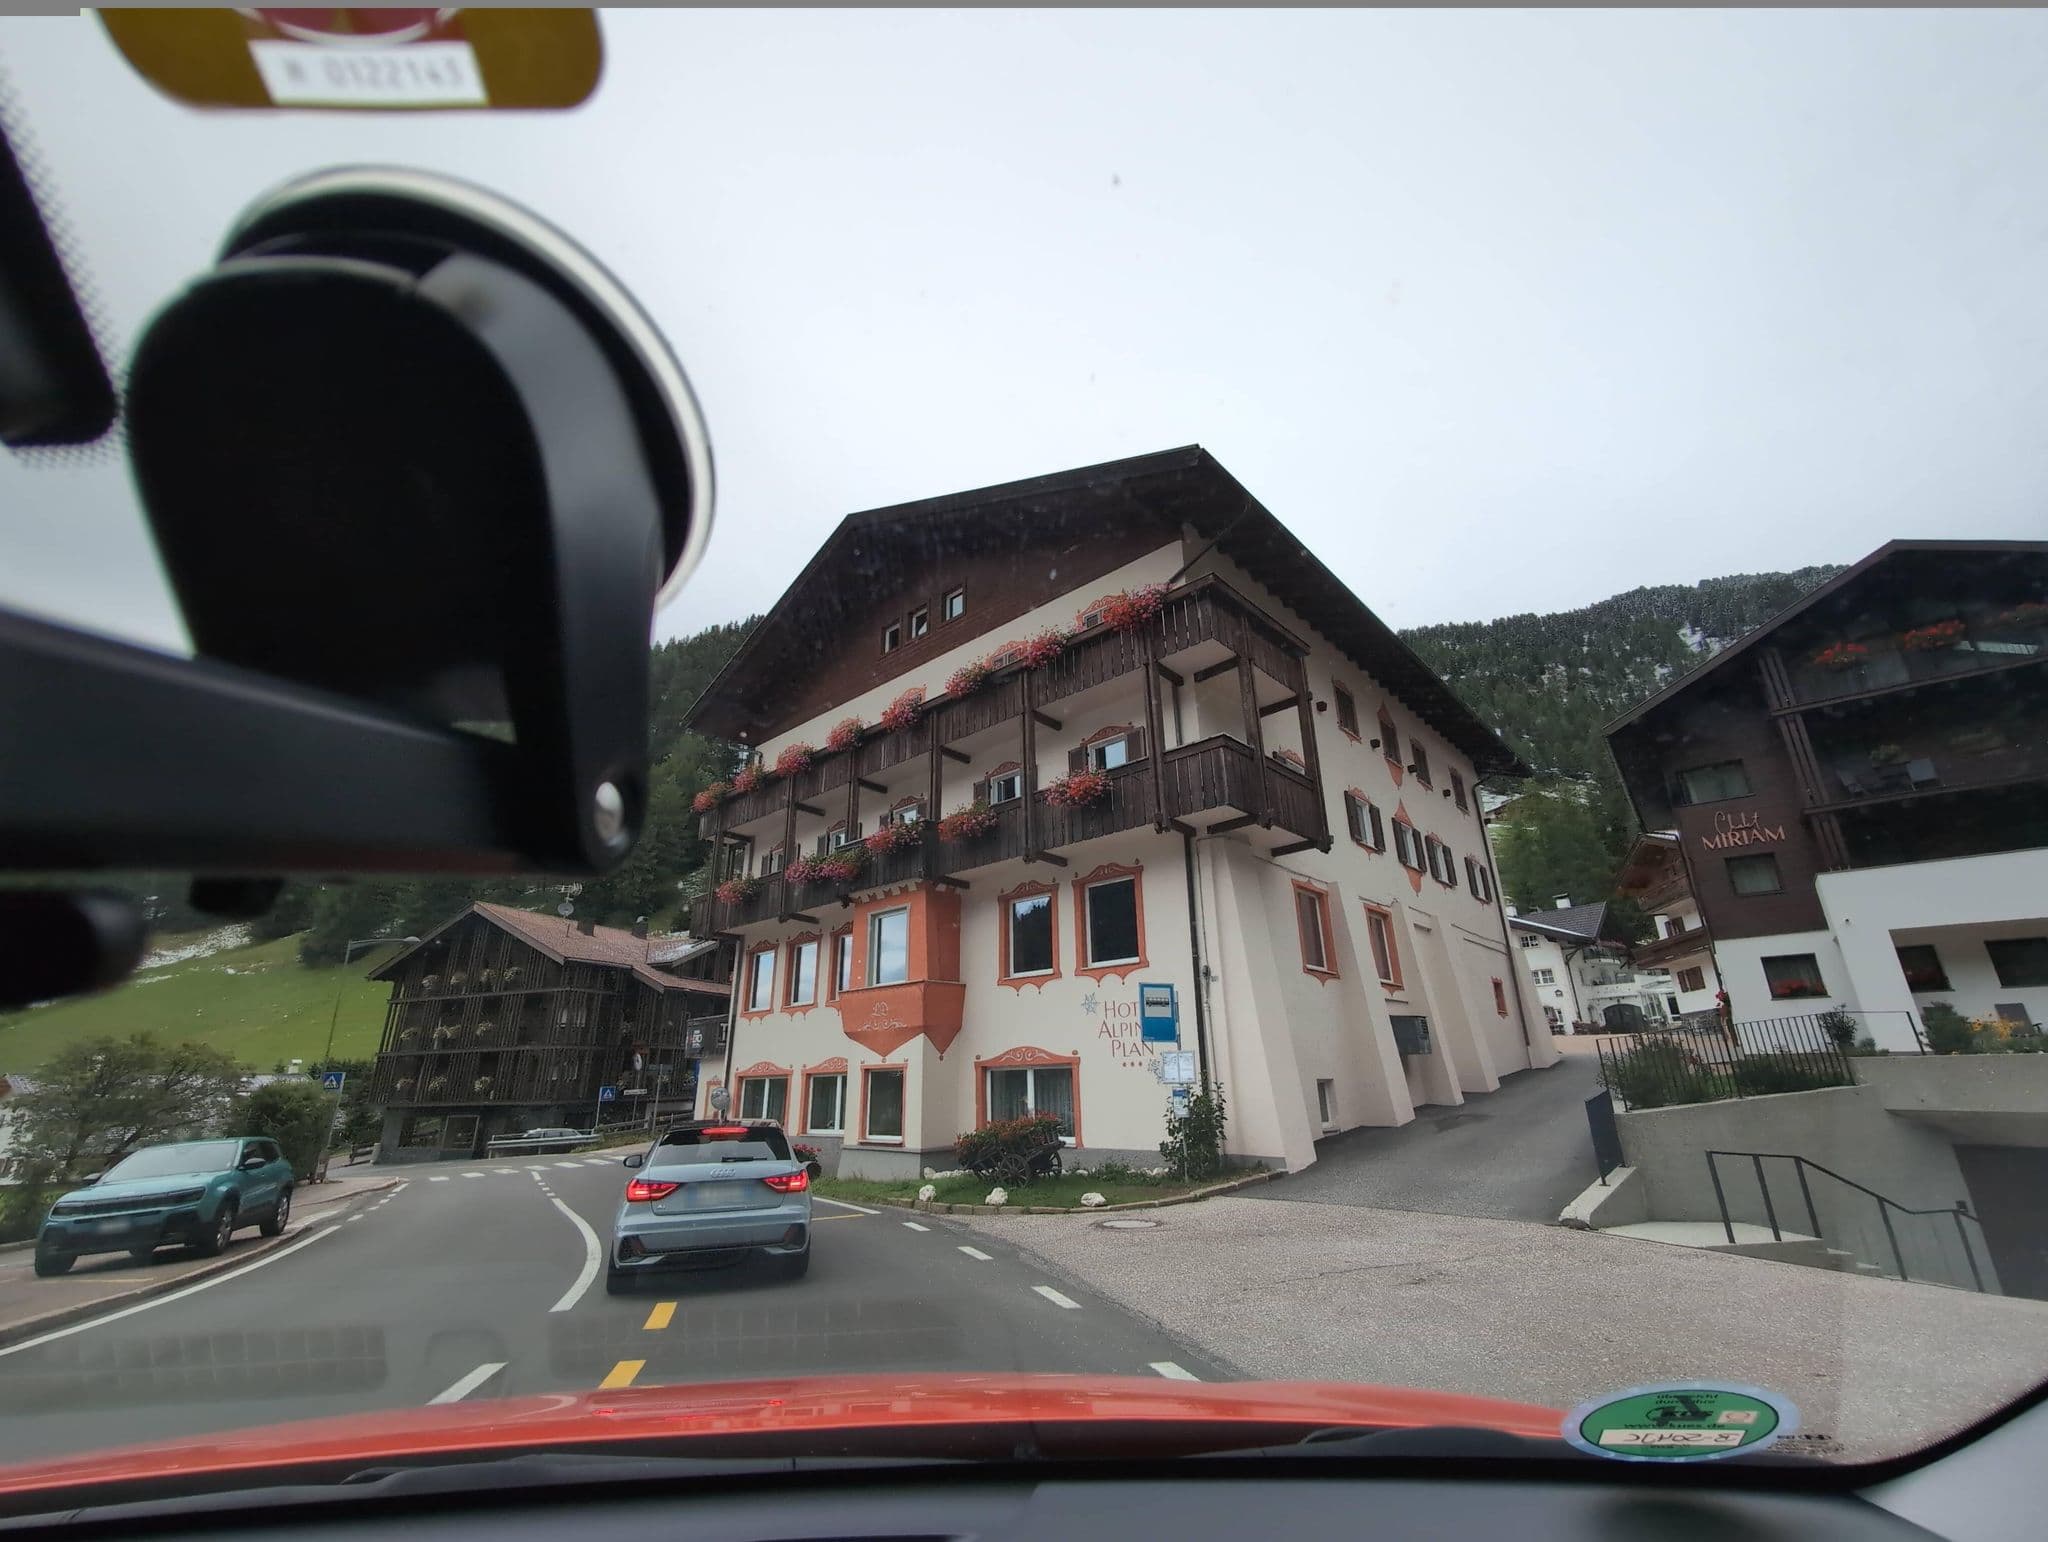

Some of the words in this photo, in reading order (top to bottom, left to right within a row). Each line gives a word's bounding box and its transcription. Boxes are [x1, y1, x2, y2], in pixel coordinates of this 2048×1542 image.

[1701, 825, 1786, 850] MIRIAM
[1104, 1001, 1140, 1020] HOT
[1099, 1020, 1143, 1039] ALPIN
[1111, 1040, 1154, 1058] PLAN
